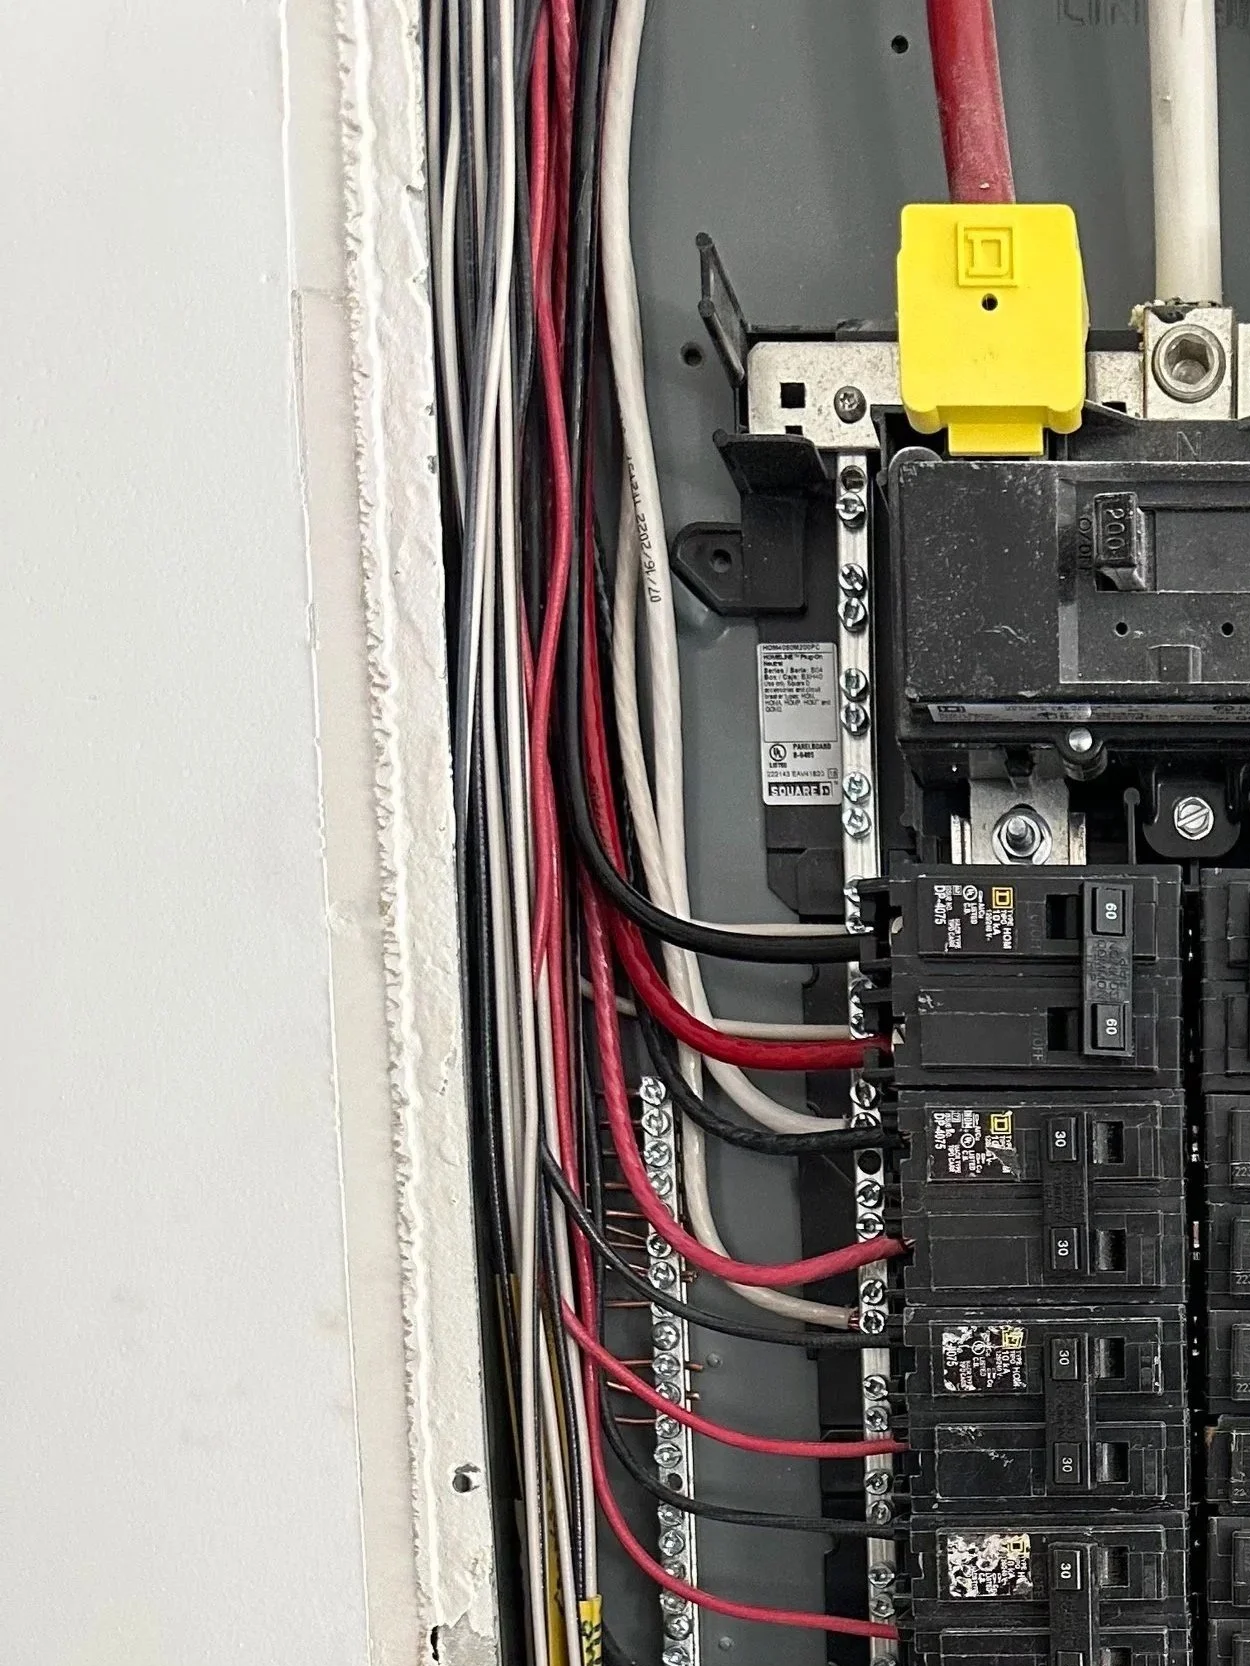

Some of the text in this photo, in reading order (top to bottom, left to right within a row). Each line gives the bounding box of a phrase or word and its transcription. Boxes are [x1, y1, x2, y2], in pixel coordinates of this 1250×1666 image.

[1177, 431, 1201, 461] N
[1106, 508, 1125, 550] 200
[770, 786, 818, 796] SQUARE
[934, 885, 946, 924] DP-4075
[1105, 902, 1117, 920] 60
[992, 909, 1001, 935] 10 kA
[1002, 927, 1011, 948] HOM
[1106, 1018, 1118, 1035] 60
[934, 1112, 946, 1149] DP-4075
[1055, 1131, 1066, 1148] 30
[1058, 1240, 1069, 1256] 30
[1059, 1350, 1070, 1366] 30
[1062, 1457, 1073, 1473] 30
[1061, 1563, 1072, 1579] 30
